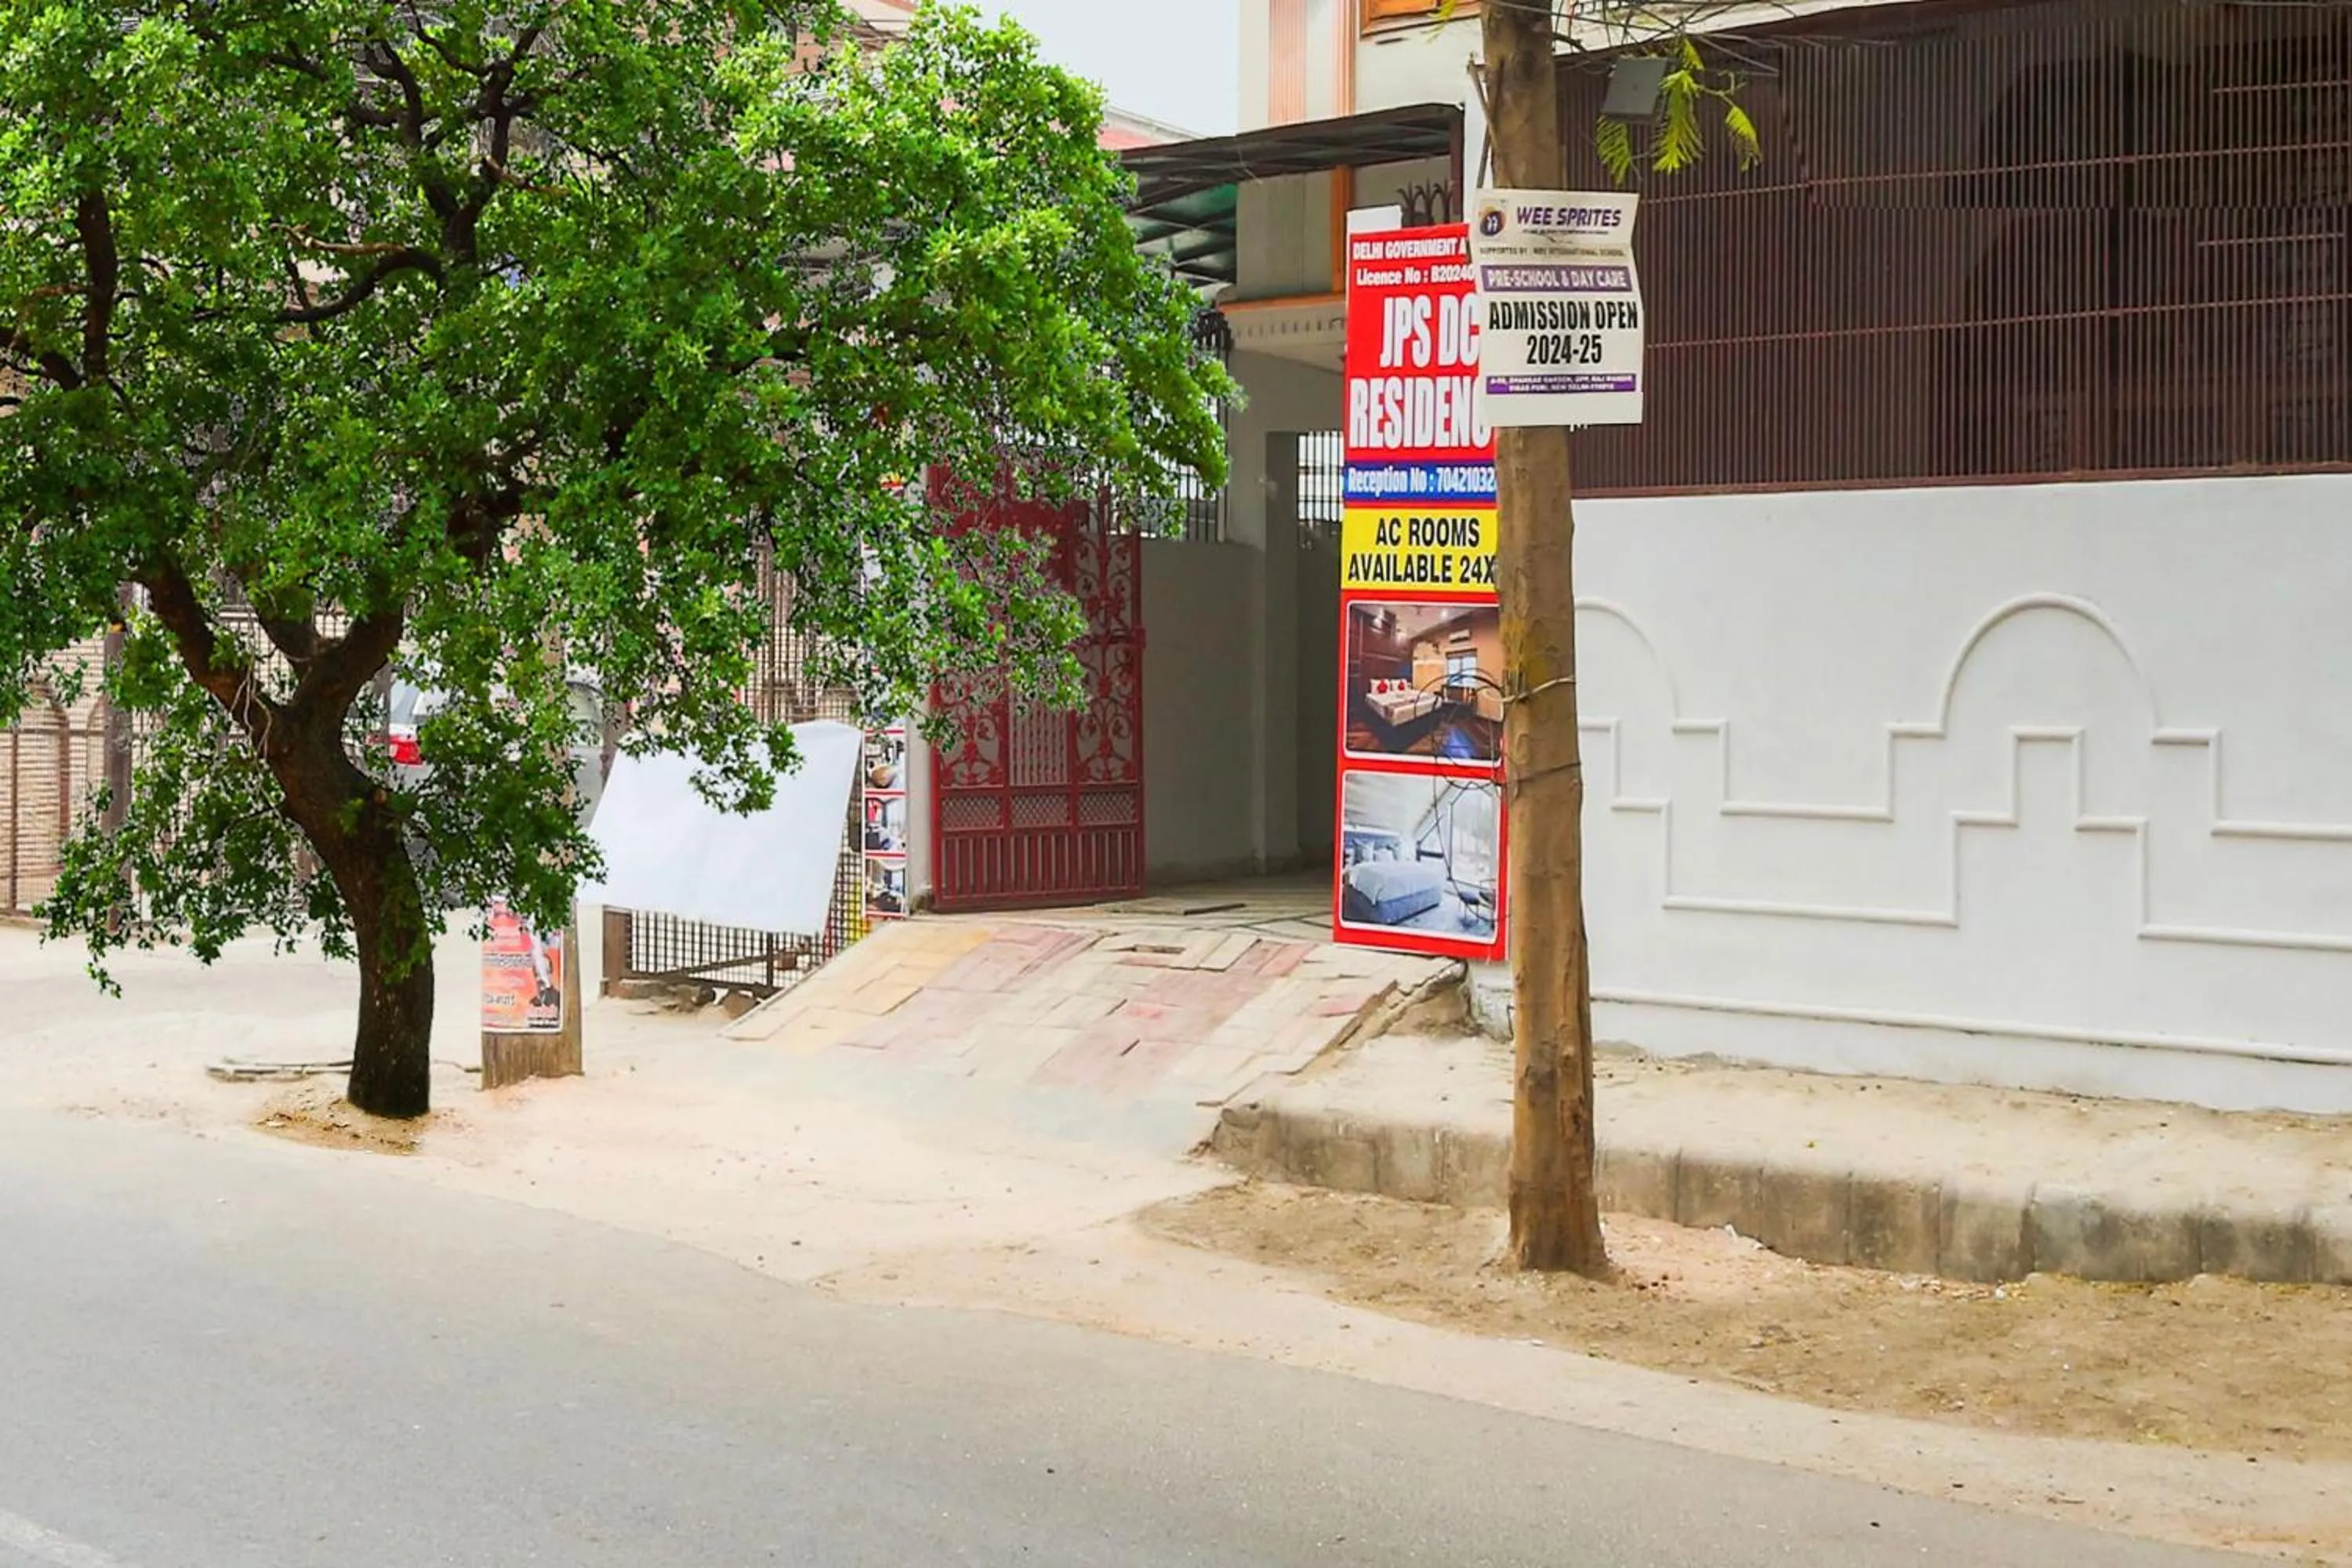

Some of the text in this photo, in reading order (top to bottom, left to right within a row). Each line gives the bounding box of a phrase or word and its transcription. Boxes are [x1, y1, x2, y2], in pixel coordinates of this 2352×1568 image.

[1517, 206, 1622, 227] WEE SPRITES
[1353, 241, 1384, 260] DELHI
[1385, 238, 1457, 259] GOVERNMENT
[1356, 268, 1403, 286] Licence
[1404, 267, 1421, 284] No
[1431, 264, 1475, 283] B20240
[1487, 269, 1560, 288] PRE-SCHOOL
[1571, 270, 1595, 287] DAY
[1596, 270, 1628, 287] CARE
[1489, 300, 1639, 330] ADMISSION OPEN
[1380, 294, 1432, 368] JPS
[1526, 334, 1602, 365] 2024-25
[1349, 376, 1491, 449] RESIDENC
[1348, 465, 1408, 497] Reception
[1410, 466, 1428, 492] No
[1437, 466, 1496, 493] 70421032
[1375, 517, 1480, 547] AC ROOMS
[1348, 554, 1496, 584] AVAILABLE 24X
